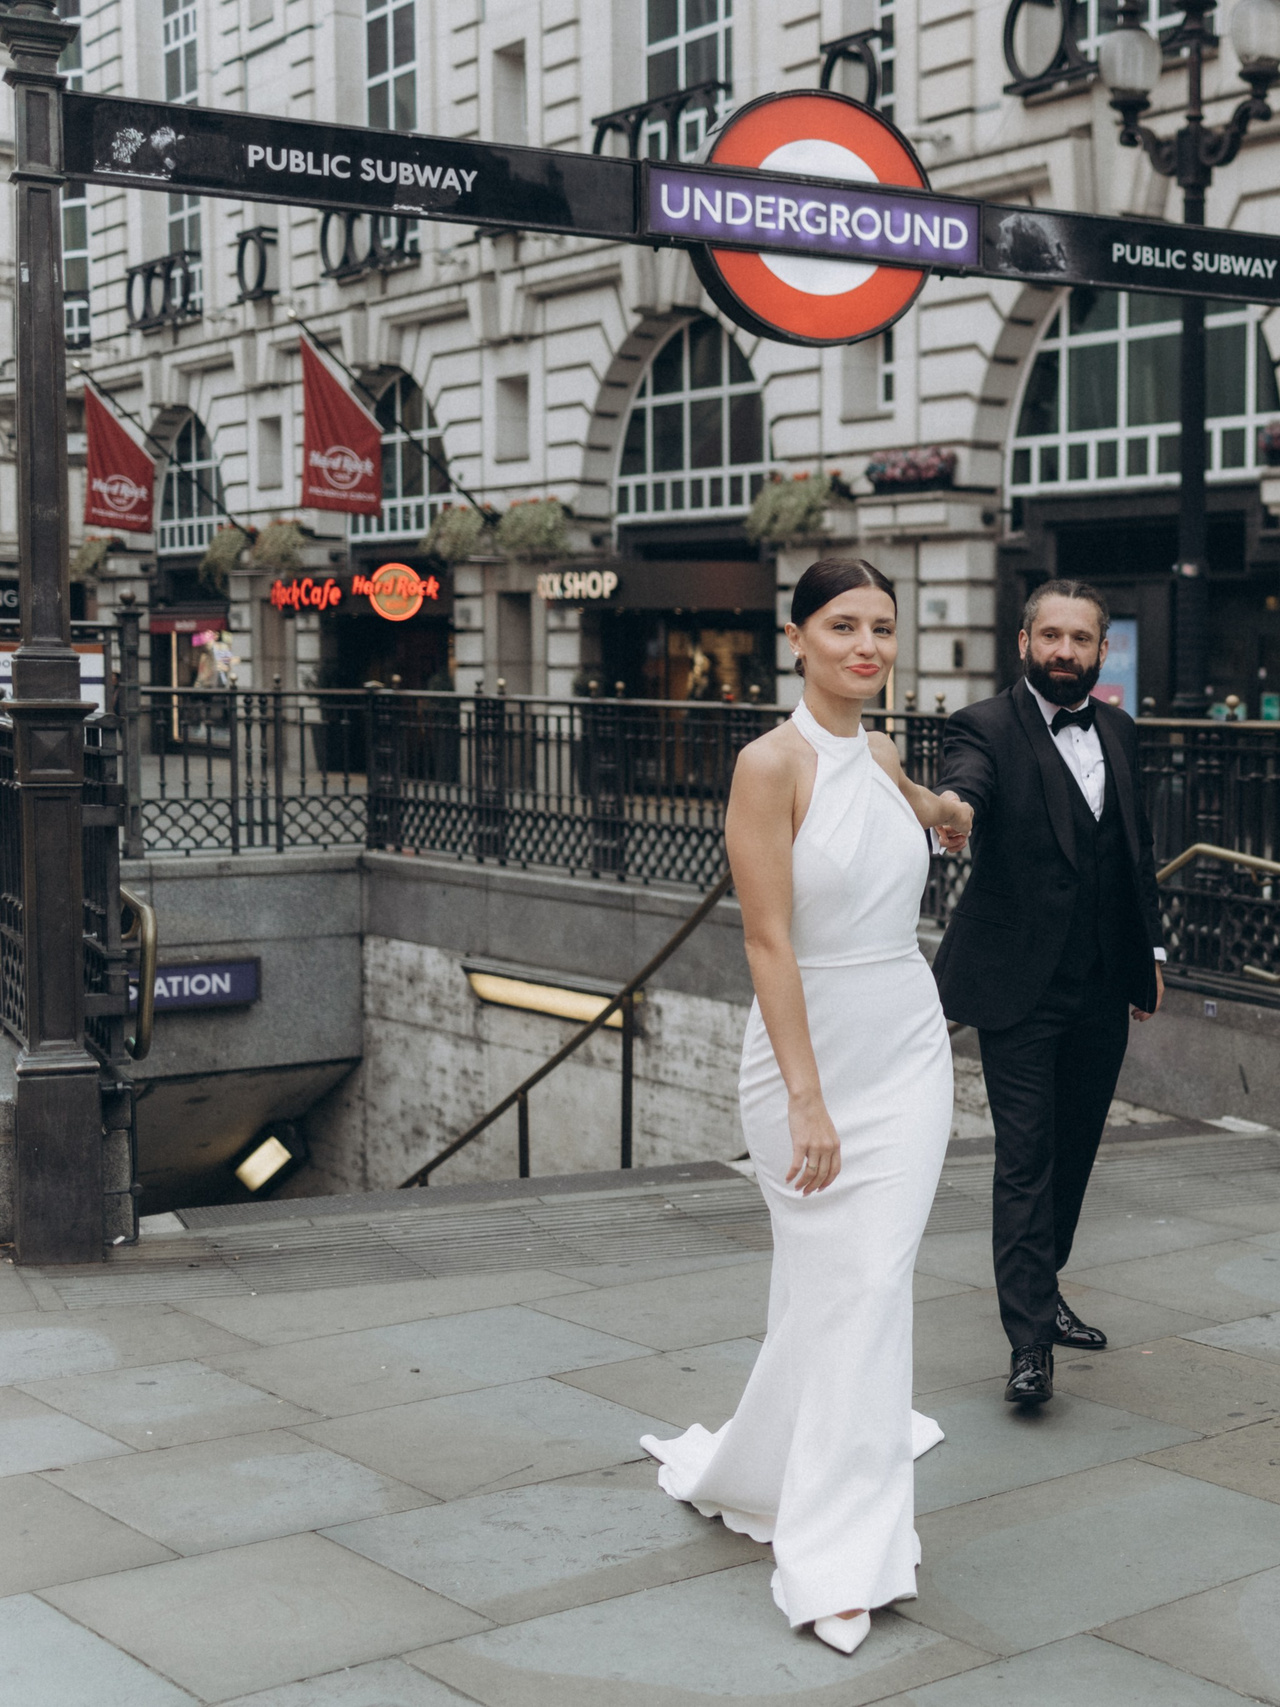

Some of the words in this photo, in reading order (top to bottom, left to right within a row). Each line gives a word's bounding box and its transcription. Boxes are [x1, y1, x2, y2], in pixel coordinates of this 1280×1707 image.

[247, 144, 351, 179] PUBLIC
[359, 157, 478, 193] SUBWAY
[660, 183, 969, 251] UNDERGROUND
[1111, 242, 1187, 271] PUBLIC
[1191, 251, 1278, 280] SUBWAY
[351, 574, 395, 597] Hard
[396, 574, 440, 600] Rock
[563, 570, 618, 599] SHOP
